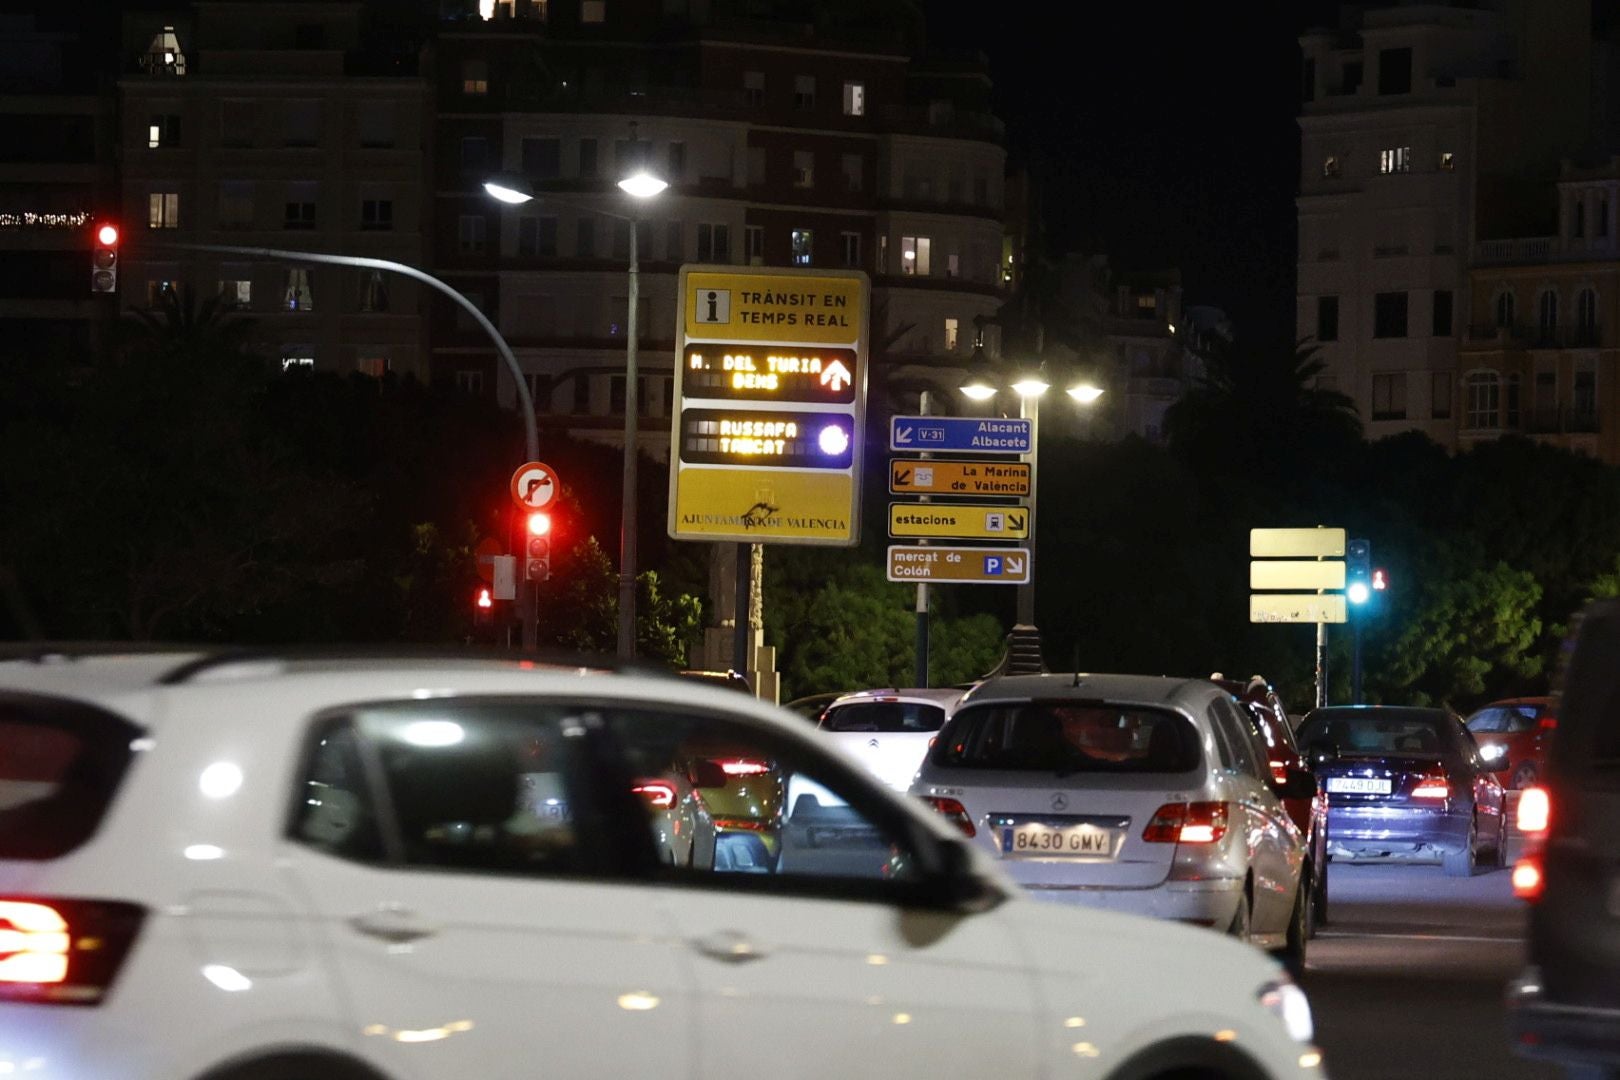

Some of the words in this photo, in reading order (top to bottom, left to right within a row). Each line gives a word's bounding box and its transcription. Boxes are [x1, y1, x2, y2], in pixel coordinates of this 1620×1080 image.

[824, 295, 846, 308] EN
[740, 311, 797, 325] TEMPS
[804, 314, 849, 327] REAL
[723, 354, 757, 371] DEL
[767, 356, 822, 374] TURIA
[720, 420, 797, 438] RUSSAFA
[978, 421, 1028, 433] Alacant
[920, 430, 943, 440] V-31
[971, 436, 1028, 448] Albacete
[963, 466, 977, 476] La
[985, 467, 1027, 478] Marina
[952, 479, 967, 490] de
[975, 480, 1027, 492] València
[787, 518, 847, 530] VALENCIA
[895, 514, 957, 526] estacions
[895, 552, 938, 562] mercat
[946, 552, 962, 563] de
[895, 565, 931, 577] Colón
[987, 558, 999, 573] P
[1017, 832, 1063, 850] 8430
[1070, 833, 1104, 850] GMV
